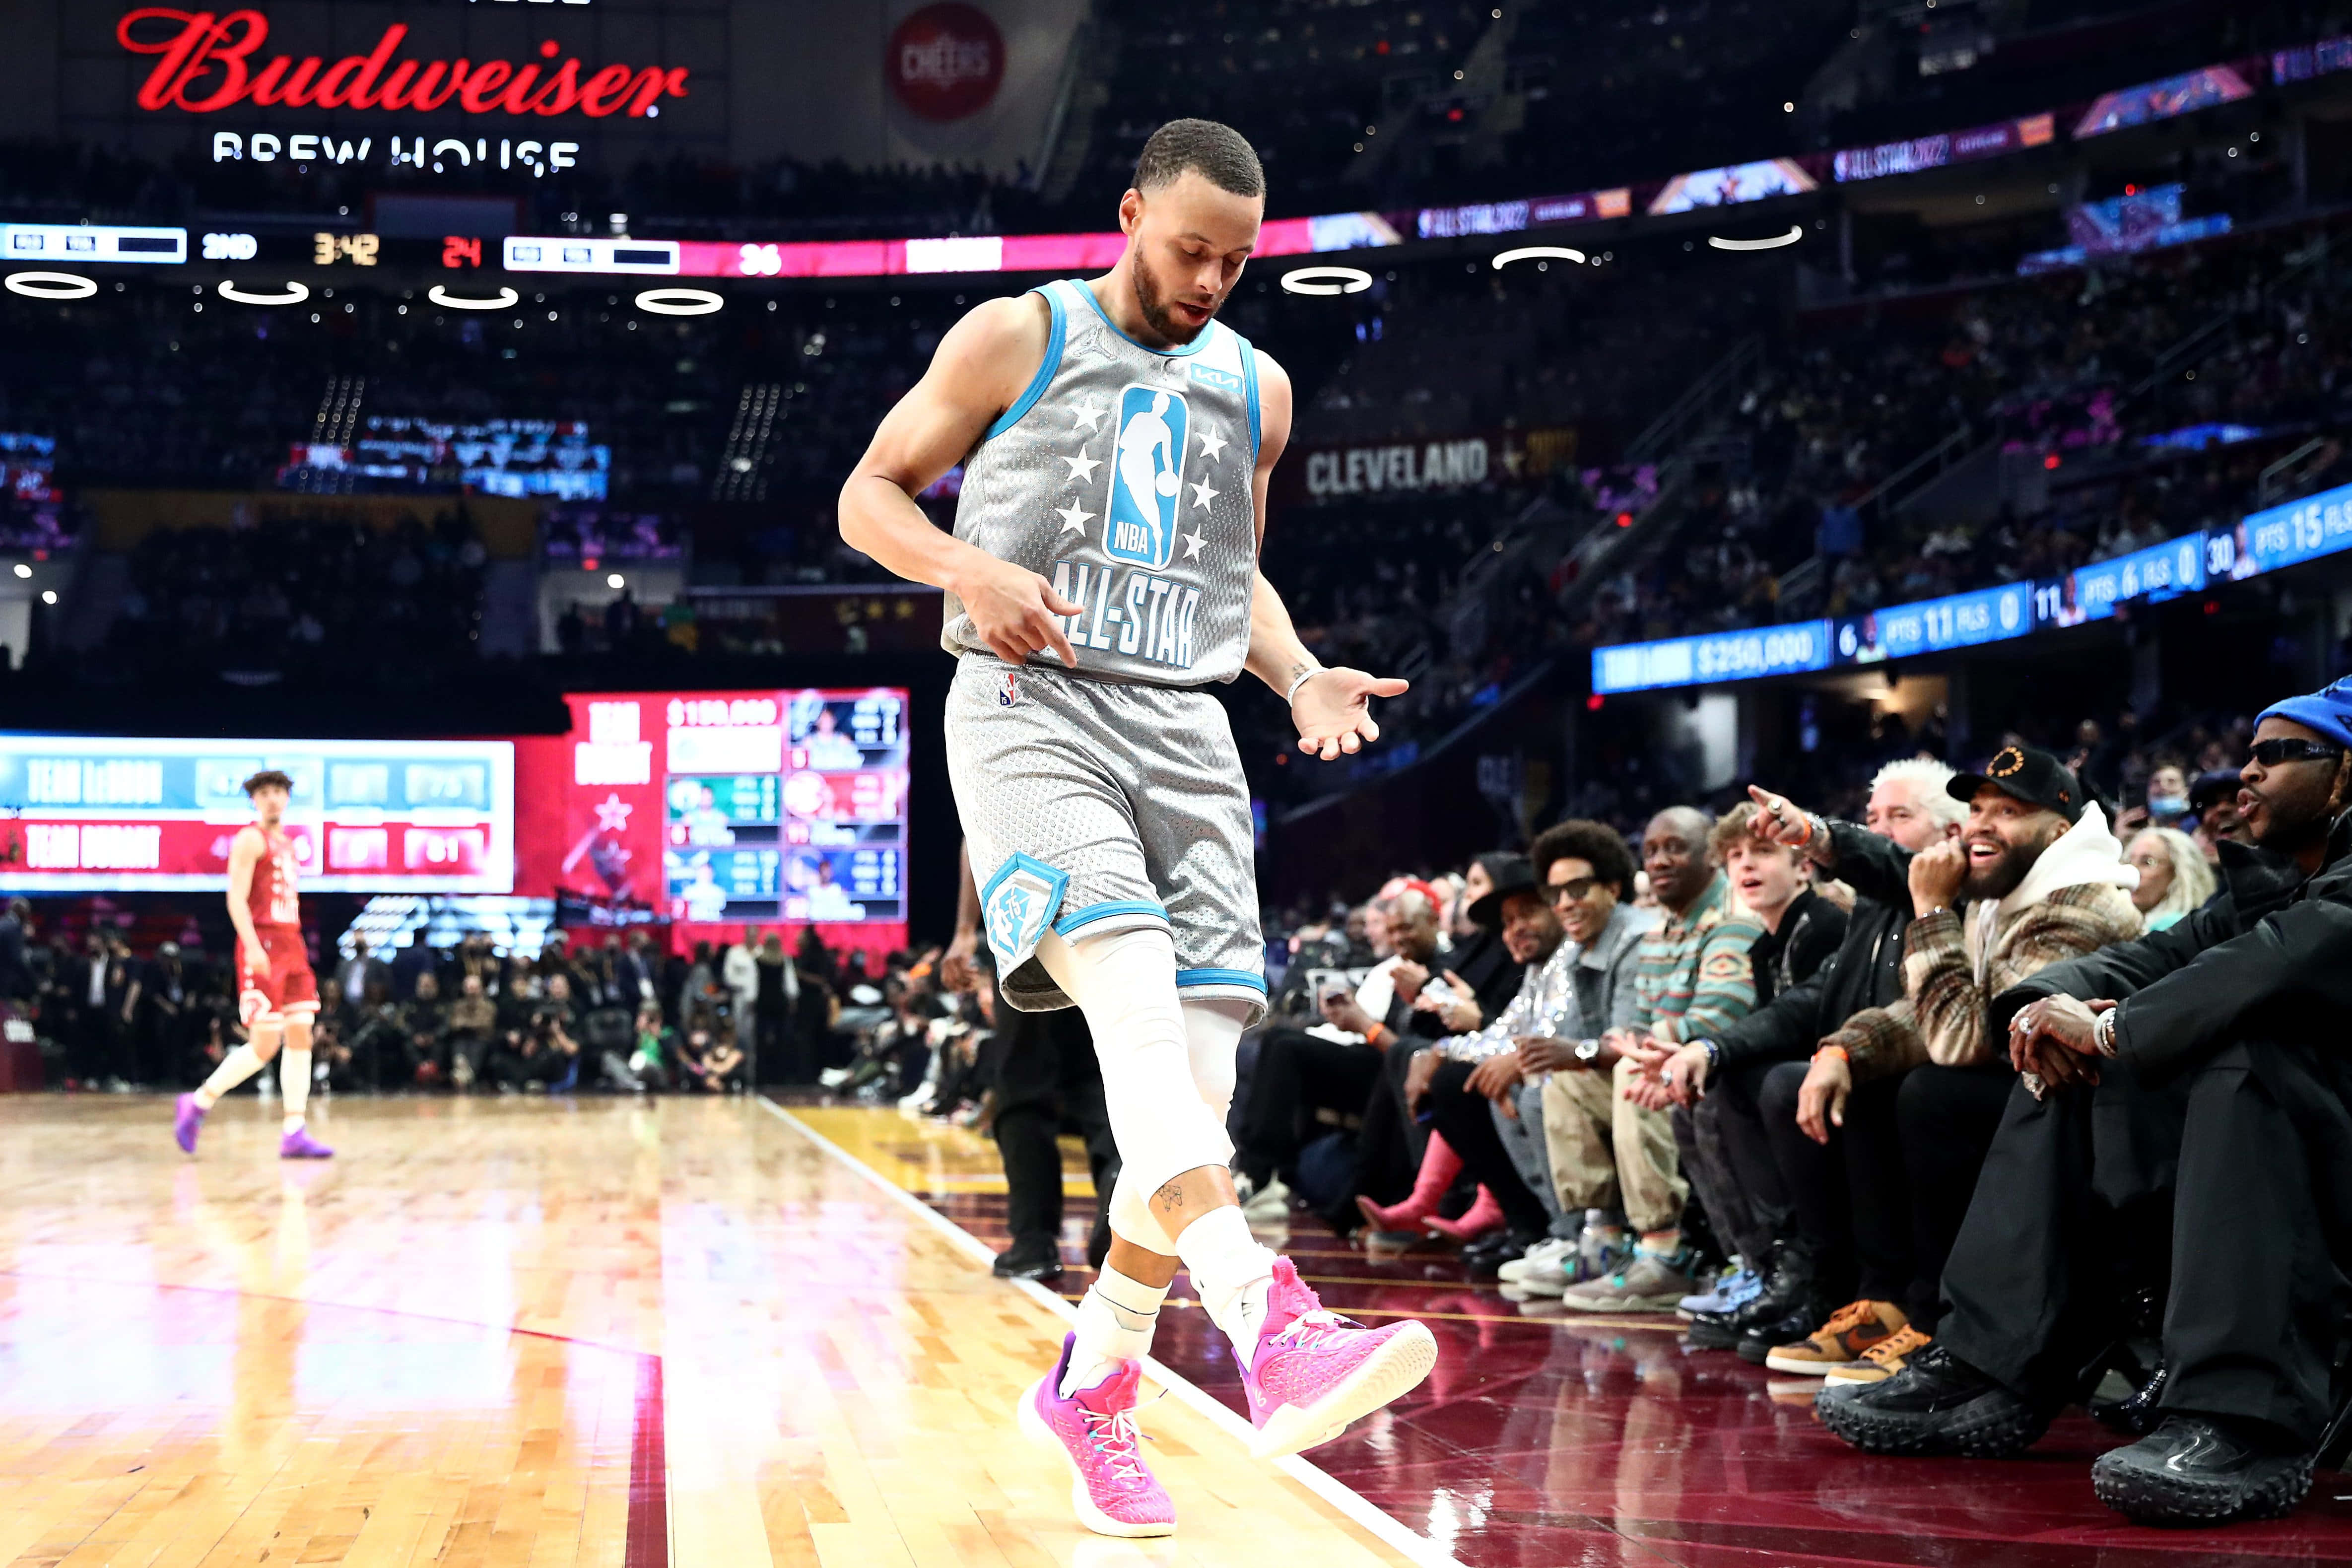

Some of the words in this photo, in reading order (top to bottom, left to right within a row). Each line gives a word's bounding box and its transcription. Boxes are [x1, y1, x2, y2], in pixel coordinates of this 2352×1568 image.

[117, 8, 689, 117] Budweiser
[314, 232, 380, 266] 3:42
[442, 236, 481, 268] 24
[1306, 437, 1488, 495] CLEVELAND
[1114, 522, 1149, 555] NBA
[2206, 534, 2235, 575] 30
[2255, 521, 2289, 557] PTS
[2291, 503, 2323, 552] 15
[2035, 584, 2061, 620] 11
[2085, 574, 2117, 606] PTS
[2122, 561, 2140, 599] 6
[2179, 544, 2196, 585] 0
[1050, 560, 1201, 669] ALL-STAR
[1839, 624, 1858, 657] 6
[1886, 616, 1922, 642] PTS
[1924, 604, 1953, 644] 11
[2000, 591, 2019, 630] 0
[1697, 630, 1814, 674] $250,000
[1006, 894, 1022, 920] 75
